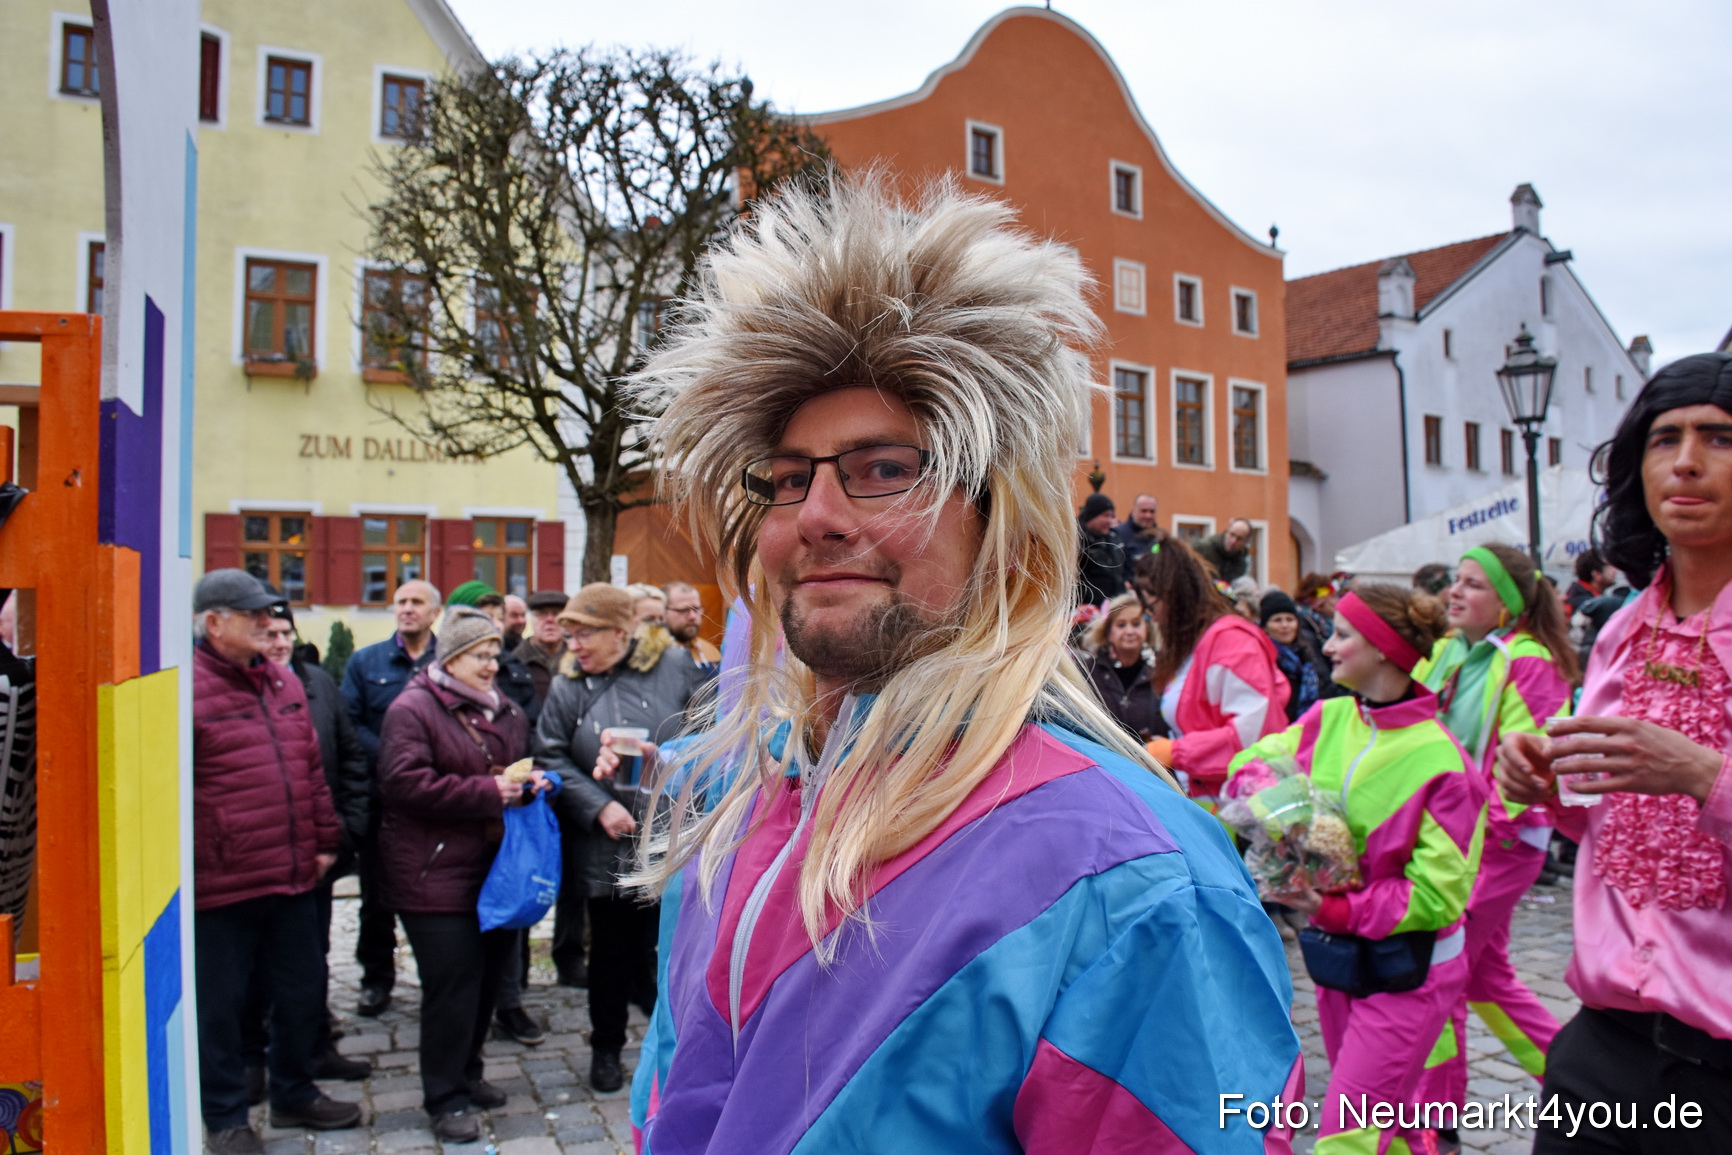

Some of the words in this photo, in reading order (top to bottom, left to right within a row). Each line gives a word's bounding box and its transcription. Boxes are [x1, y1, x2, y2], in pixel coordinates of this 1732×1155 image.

[299, 433, 352, 460] ZUM
[1448, 497, 1520, 535] Festzelte
[1644, 661, 1698, 688] NORA
